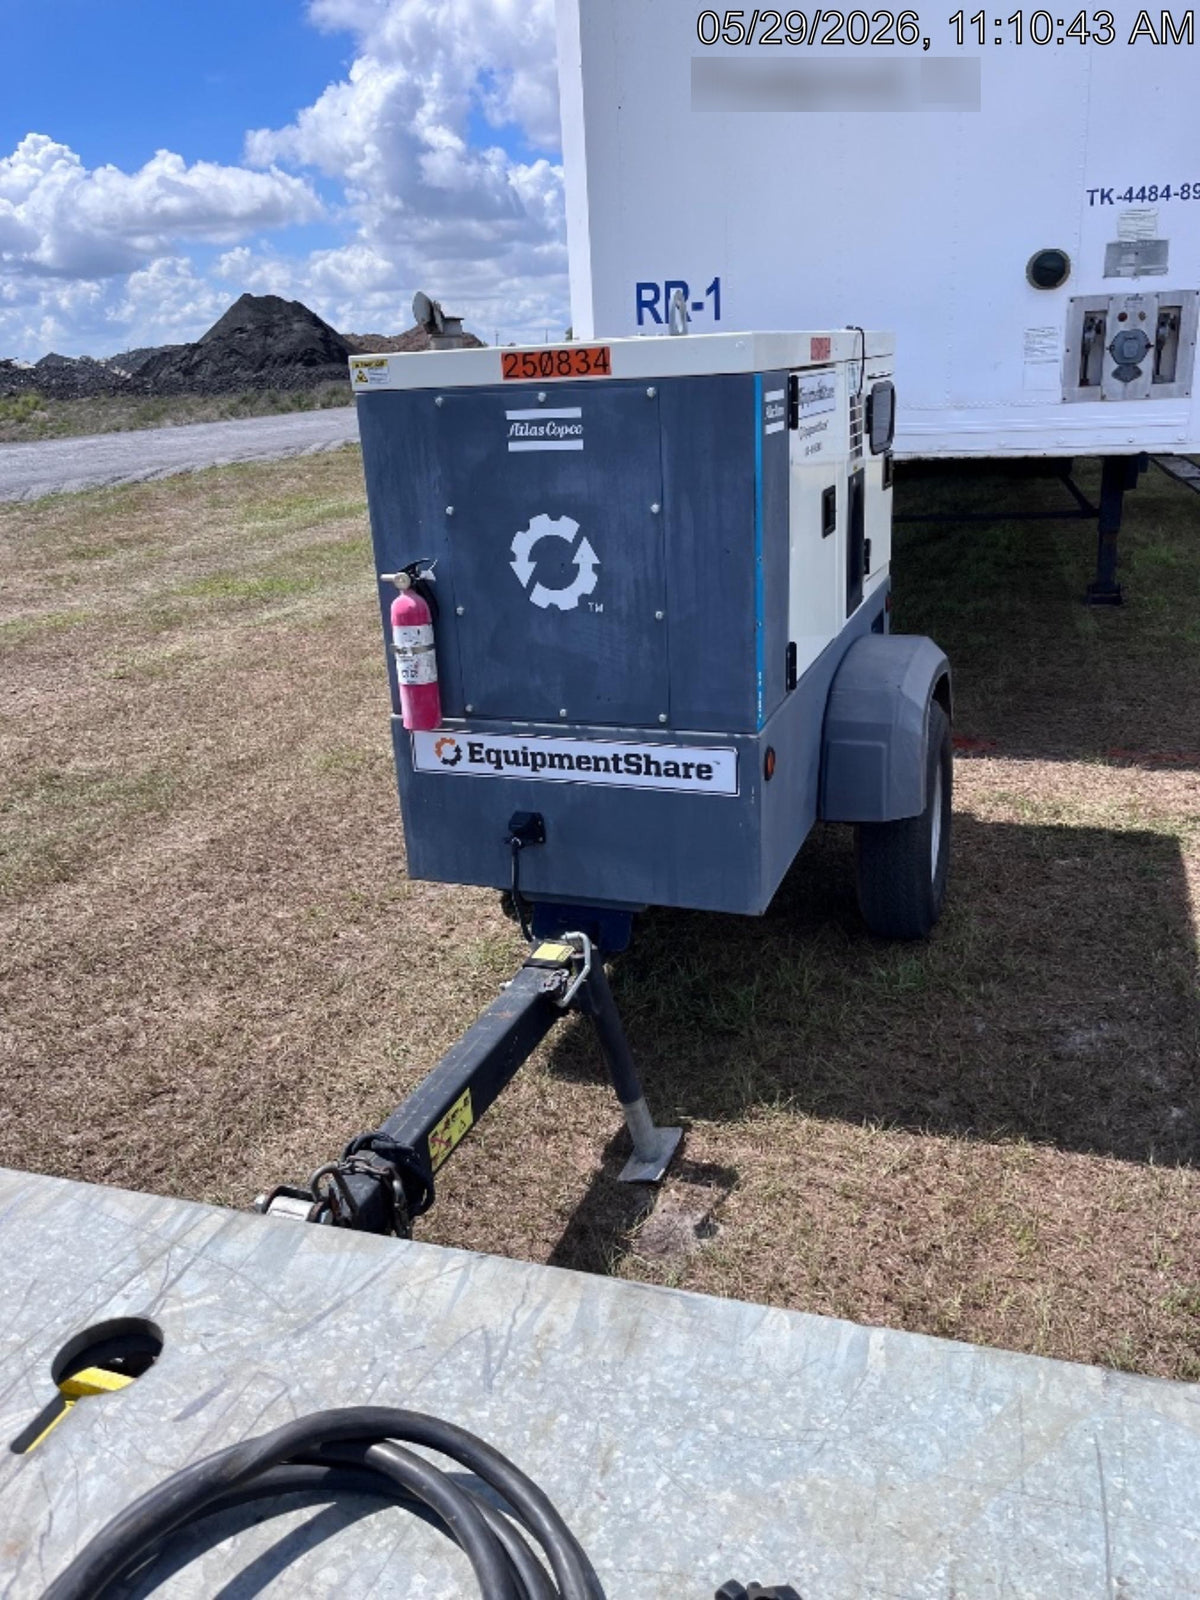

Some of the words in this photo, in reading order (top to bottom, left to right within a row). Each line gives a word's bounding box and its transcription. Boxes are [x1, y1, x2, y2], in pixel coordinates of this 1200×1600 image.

[1086, 183, 1200, 206] TK-4484-89
[636, 277, 720, 325] RR-1
[504, 348, 609, 378] 250834
[507, 422, 545, 437] Atlas
[588, 601, 604, 613] TM
[466, 740, 714, 781] EquipmentShare
